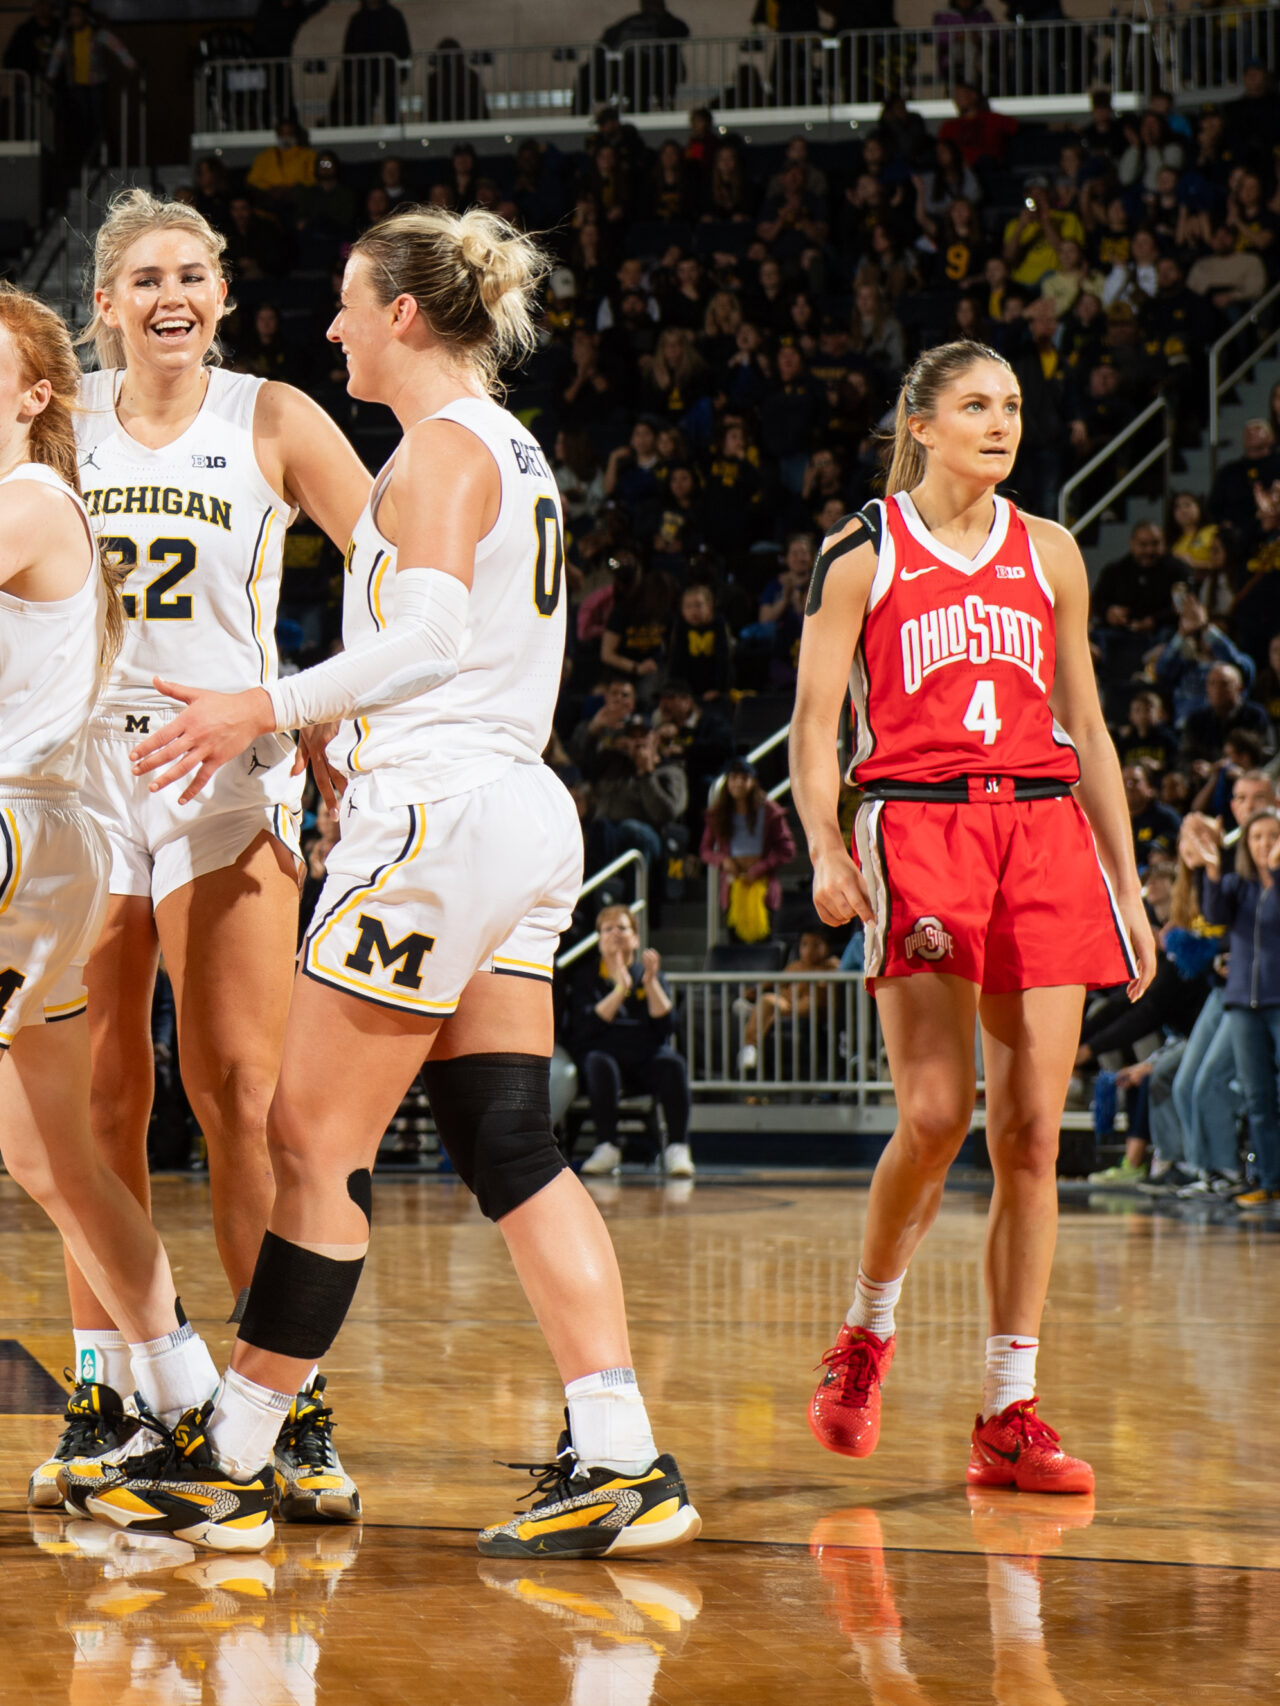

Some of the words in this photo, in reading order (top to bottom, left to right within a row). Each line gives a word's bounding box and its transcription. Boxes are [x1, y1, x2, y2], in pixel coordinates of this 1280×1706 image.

[944, 243, 970, 281] 9
[98, 535, 199, 622] 22
[532, 494, 566, 619] 0
[124, 714, 150, 734] M
[962, 680, 1002, 746] 4
[344, 912, 436, 992] M
